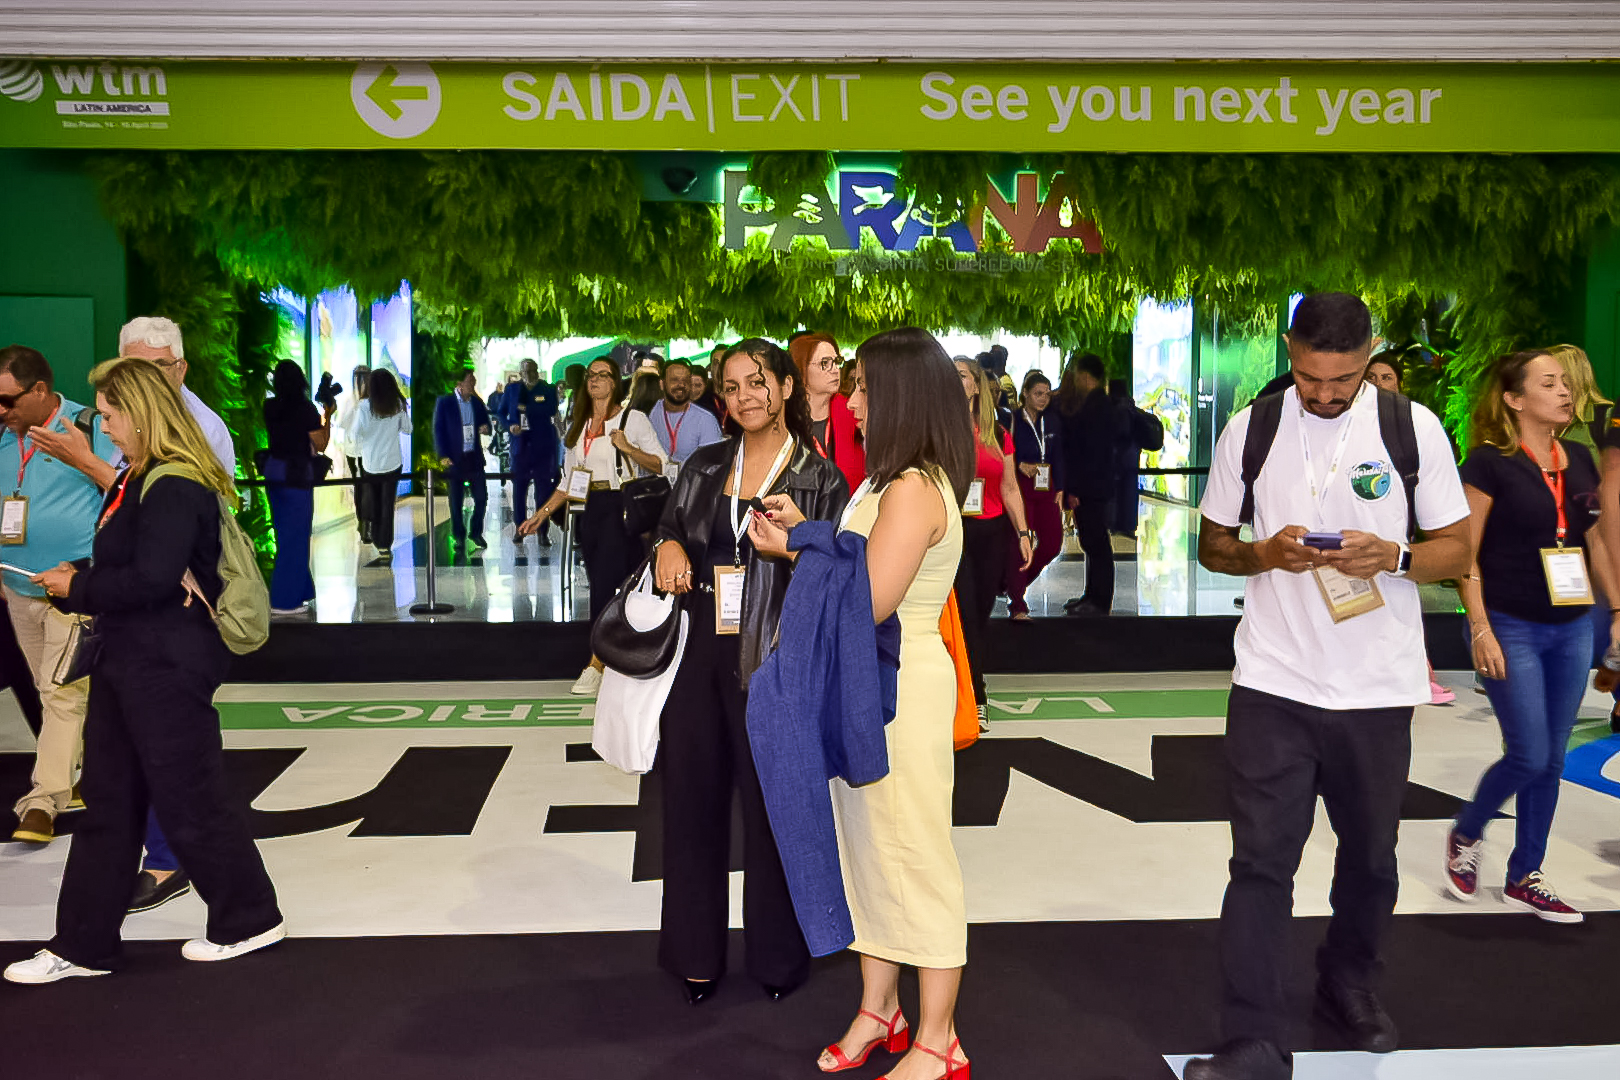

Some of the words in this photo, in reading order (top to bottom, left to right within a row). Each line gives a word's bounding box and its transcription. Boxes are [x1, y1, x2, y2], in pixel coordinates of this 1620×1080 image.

[52, 62, 168, 96] wtm
[502, 63, 696, 122] SAÍDA
[731, 74, 861, 122] EXIT
[920, 72, 1028, 121] See
[1047, 85, 1151, 133] you
[1174, 76, 1298, 123] next
[1315, 88, 1442, 135] year
[281, 704, 597, 723] ERICA
